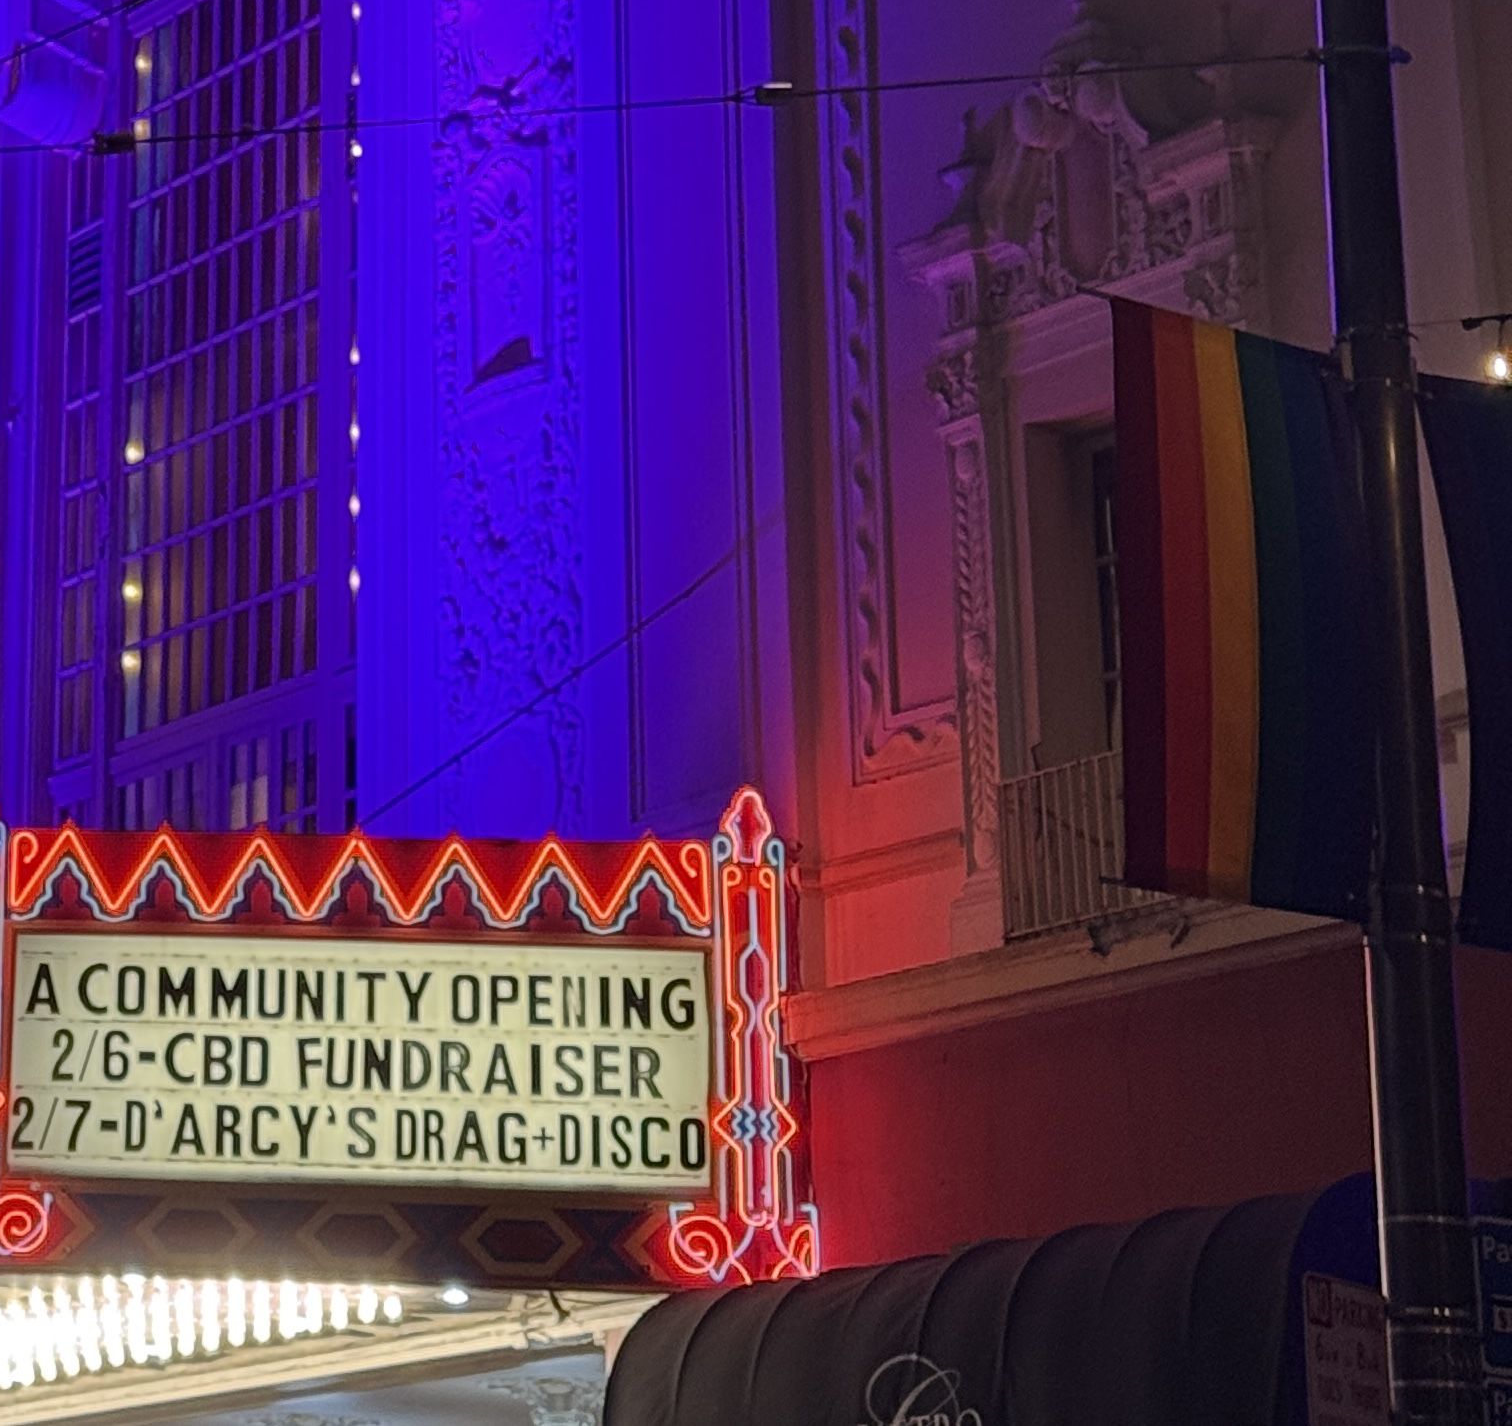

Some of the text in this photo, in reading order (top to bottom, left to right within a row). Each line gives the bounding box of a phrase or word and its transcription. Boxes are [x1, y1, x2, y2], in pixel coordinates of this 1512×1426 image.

[25, 962, 696, 1032] A COMMUNITY OPENING
[297, 1036, 664, 1100] FUNDRAISER
